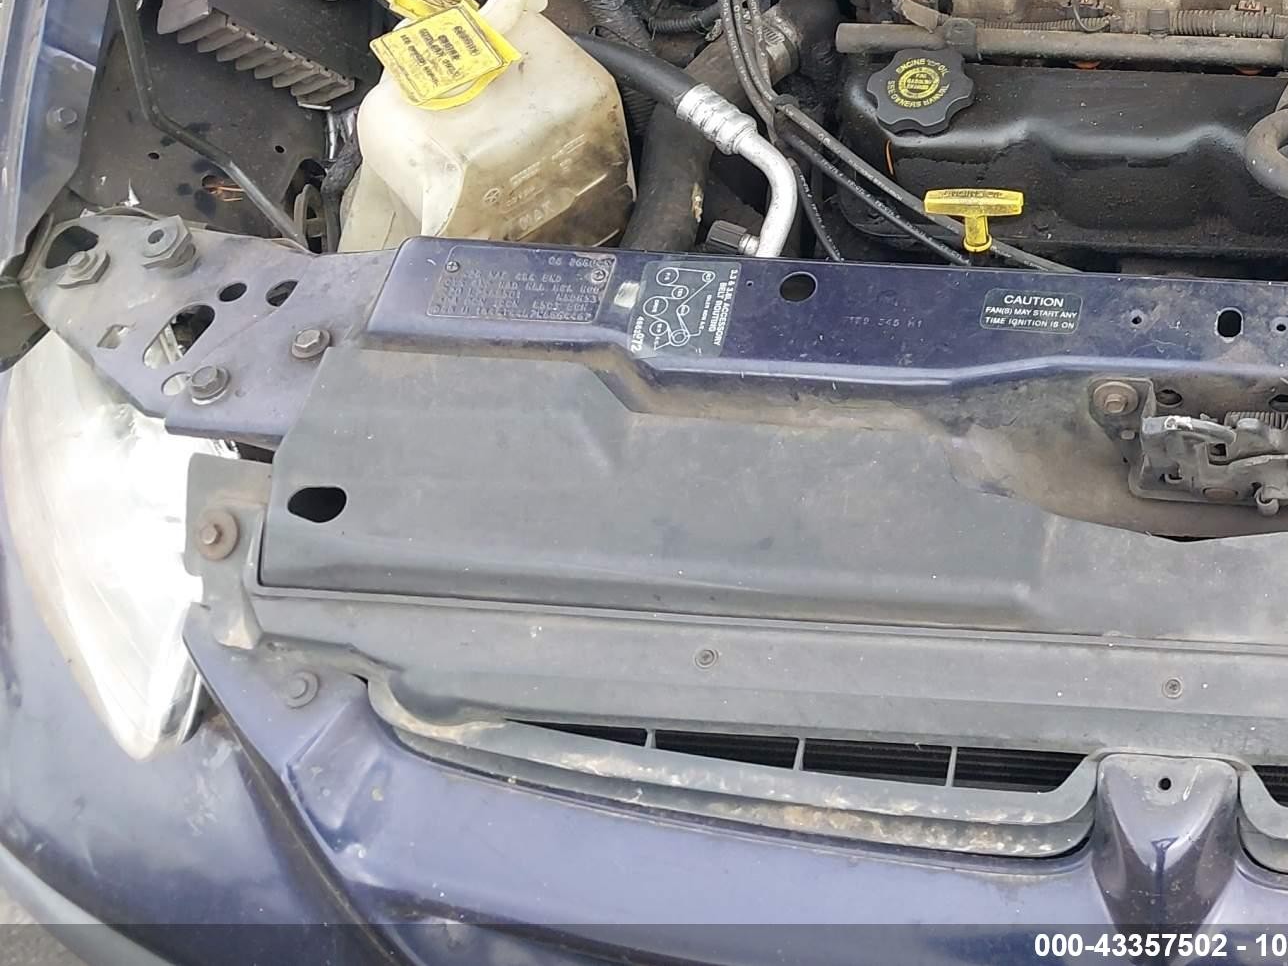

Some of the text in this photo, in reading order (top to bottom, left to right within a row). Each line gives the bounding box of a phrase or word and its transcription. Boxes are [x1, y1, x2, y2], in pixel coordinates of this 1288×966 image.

[895, 58, 951, 77] ENGINE OIL
[887, 80, 896, 97] SEE
[922, 83, 950, 107] MANUAL
[708, 282, 728, 333] BELT ROUTING
[1003, 294, 1065, 308] CAUTION
[984, 316, 1007, 324] TIME
[1008, 317, 1048, 327] IGNITION
[1061, 321, 1075, 329] ON
[1013, 307, 1032, 316] MAY
[1032, 309, 1059, 317] START
[1059, 311, 1078, 319] ANY
[713, 302, 731, 346] ACCESSORY
